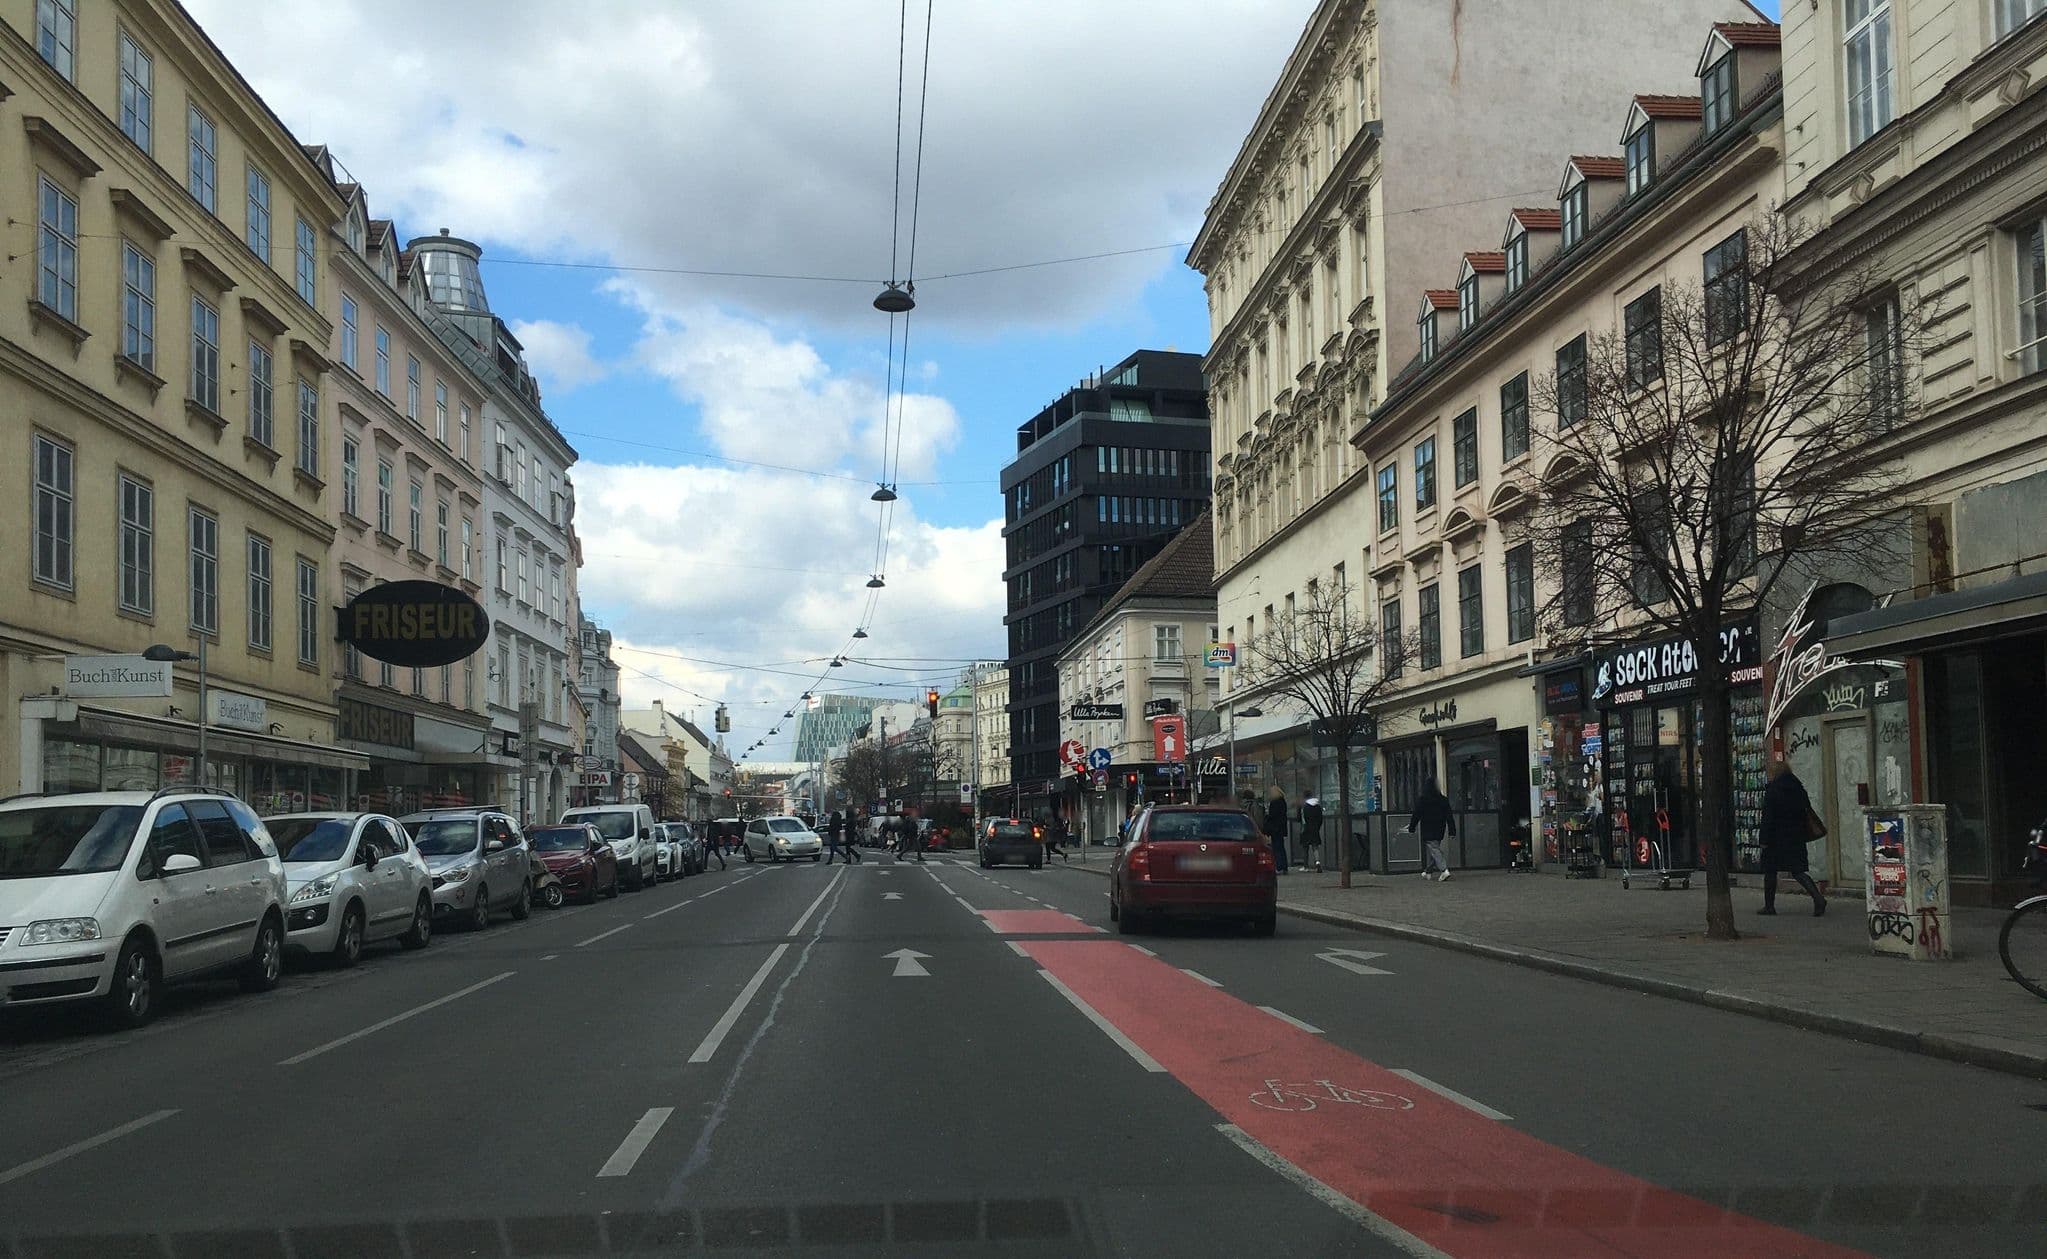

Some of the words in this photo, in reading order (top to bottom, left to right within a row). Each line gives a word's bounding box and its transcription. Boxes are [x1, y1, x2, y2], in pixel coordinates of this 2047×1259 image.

[354, 602, 477, 641] FRISEUR
[1211, 647, 1229, 658] dm
[1615, 647, 1659, 686] SOCK
[1731, 666, 1764, 683] SOUVENI
[70, 669, 110, 683] Buch
[117, 668, 164, 682] Kunst
[1647, 683, 1664, 695] TREAT
[1664, 680, 1679, 692] YOUR
[1679, 677, 1693, 689] FEET
[1614, 689, 1643, 704] SOUVENIR
[341, 700, 412, 748] FRISEUR
[579, 773, 609, 784] BIPA
